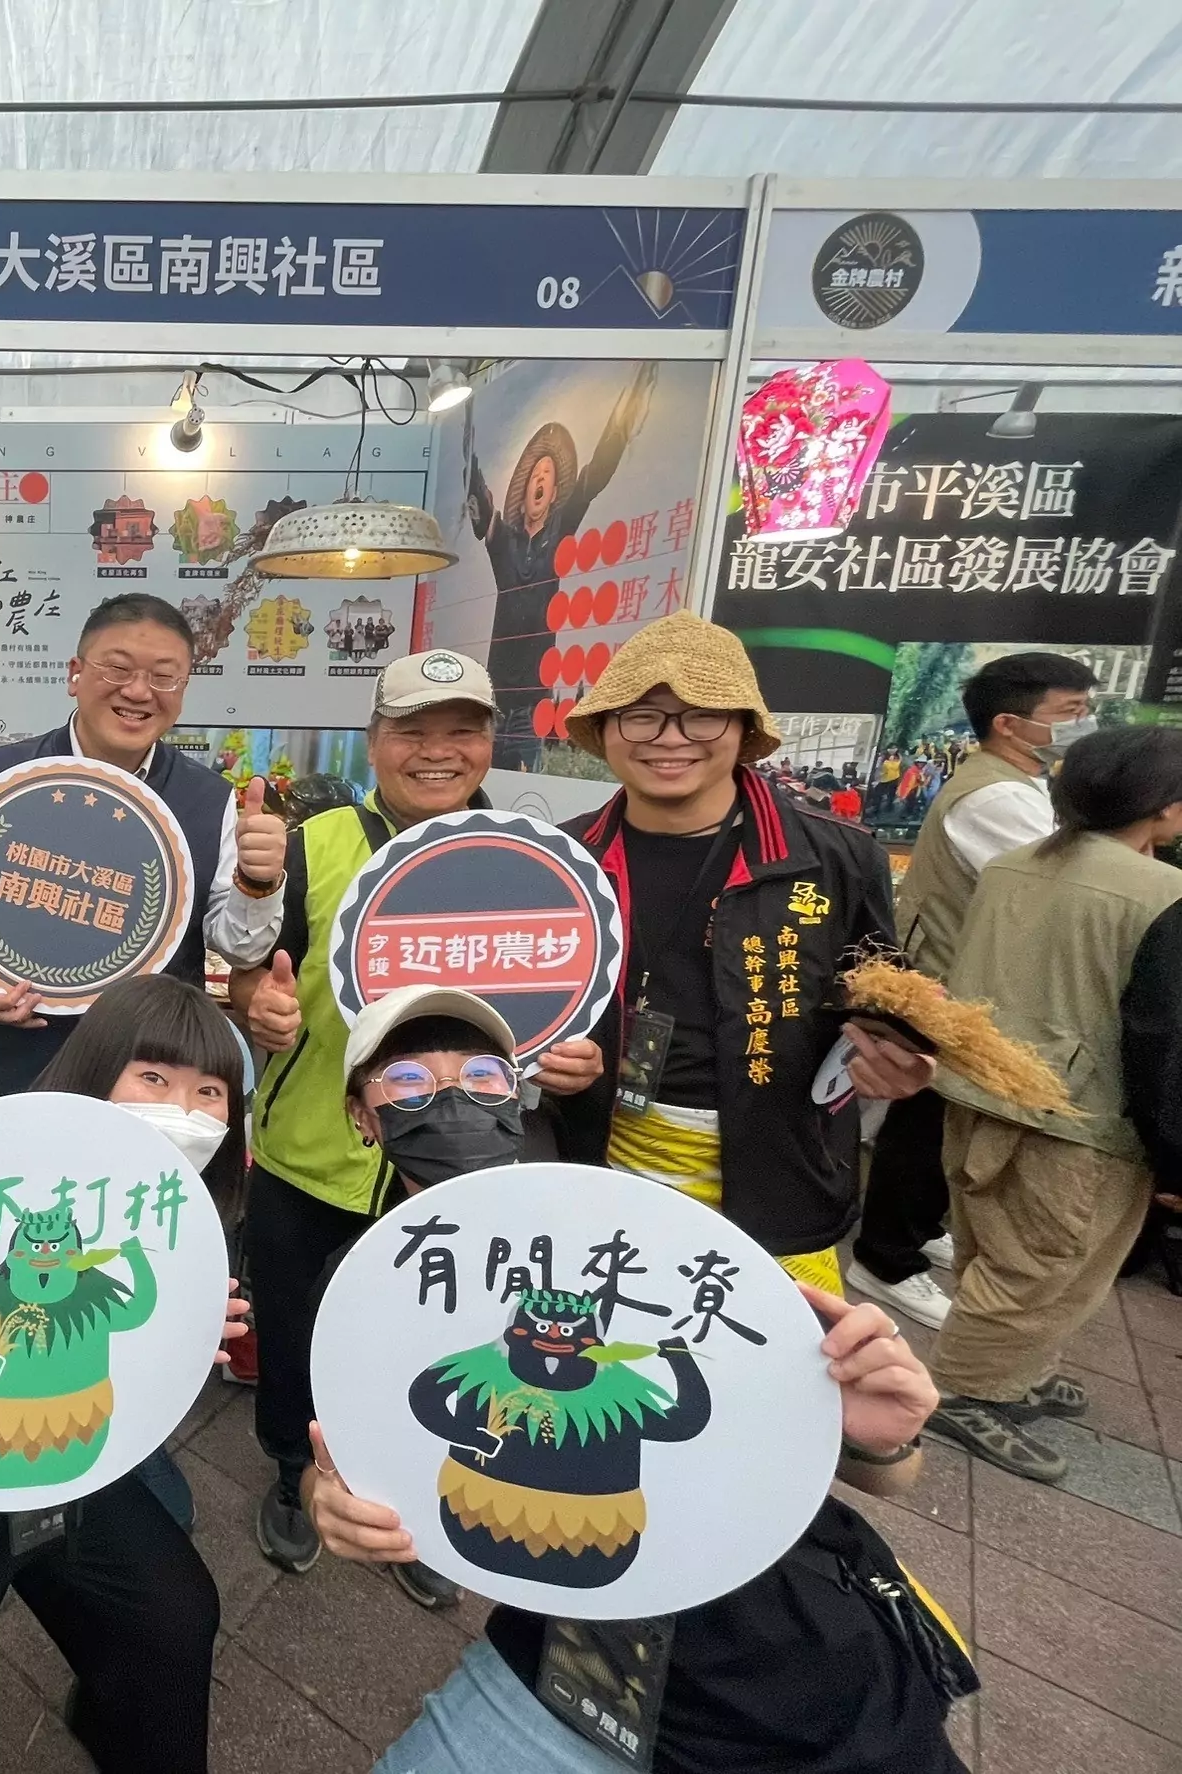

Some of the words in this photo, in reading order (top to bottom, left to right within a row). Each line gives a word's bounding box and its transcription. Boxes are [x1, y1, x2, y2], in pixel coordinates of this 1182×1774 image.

[536, 276, 581, 310] 08
[830, 267, 904, 288] 金牌農村
[726, 533, 1178, 597] 龍安社區發展協會
[4, 840, 137, 897] 桃園市大溪區
[367, 933, 390, 977] 守護
[399, 927, 581, 974] 近都農村
[741, 934, 767, 993] 總幹事
[776, 925, 801, 1018] 南興社區
[744, 997, 775, 1086] 高慶榮
